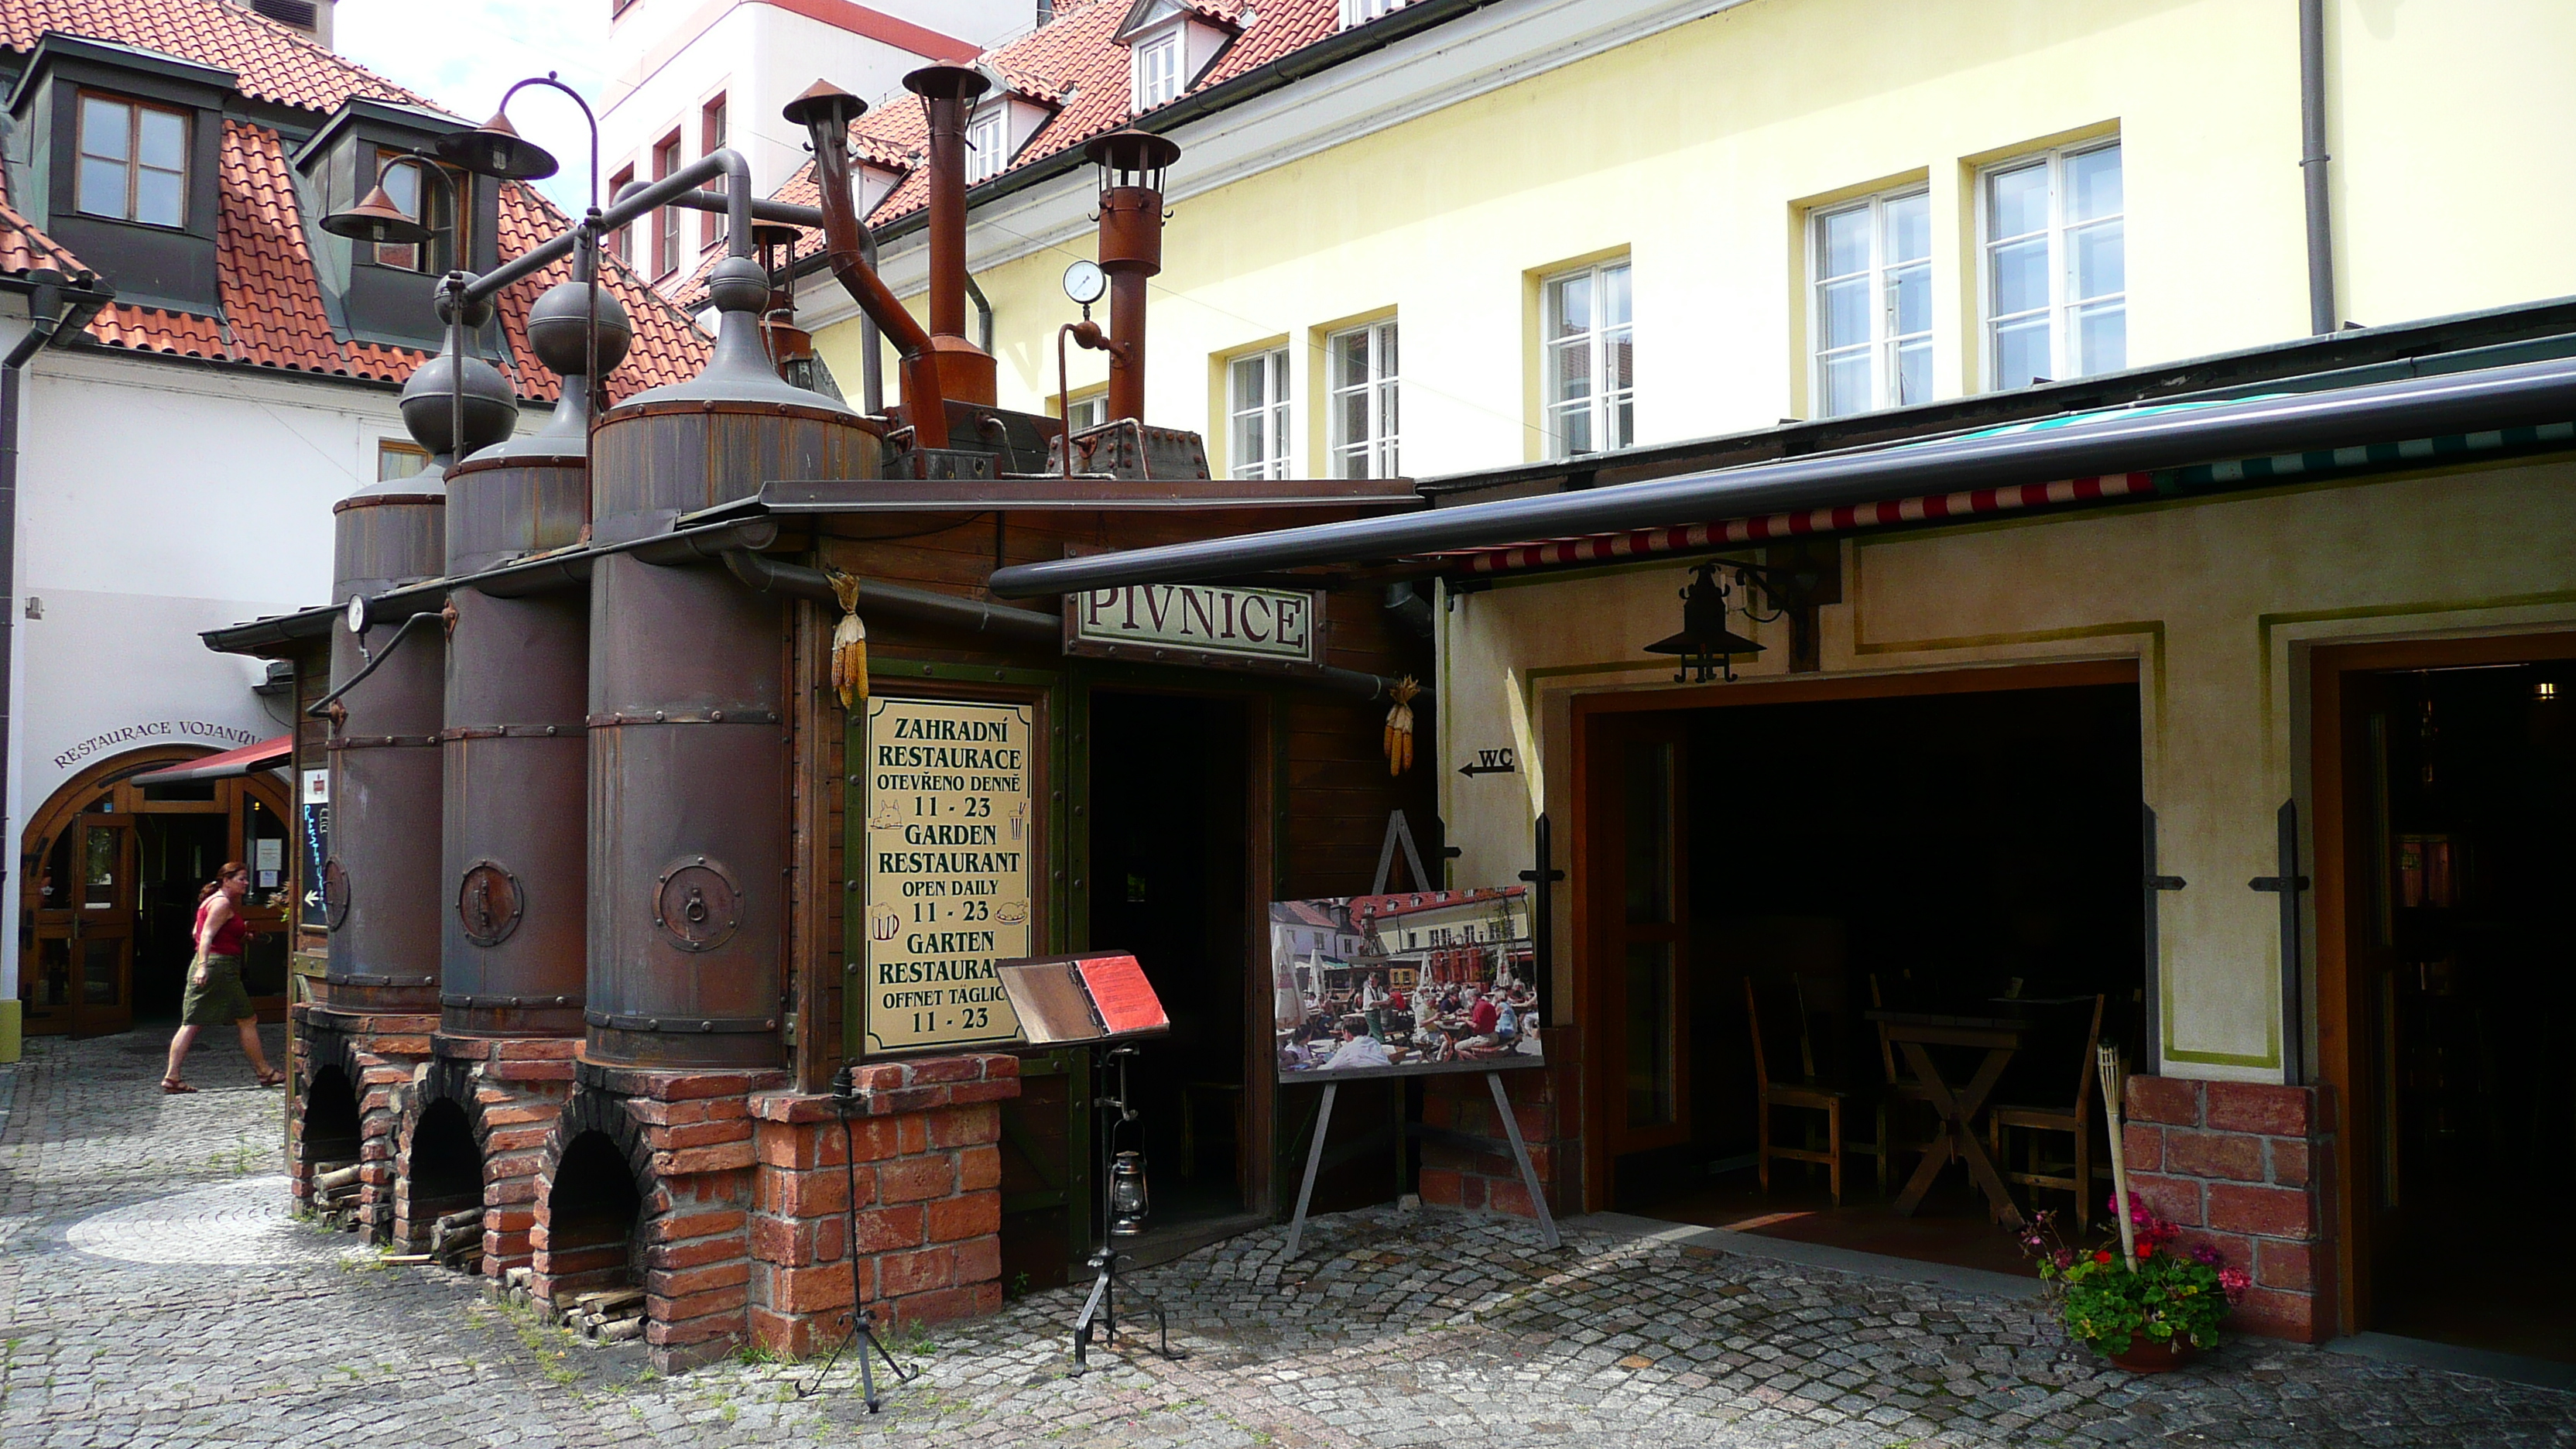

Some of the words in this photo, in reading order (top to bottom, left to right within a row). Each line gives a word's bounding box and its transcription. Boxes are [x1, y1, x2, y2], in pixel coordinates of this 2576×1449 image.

[1088, 584, 1303, 649] PIVNICE
[894, 716, 1009, 742] ZAHRADNÍ
[53, 721, 171, 769] RESTAURACE
[179, 721, 262, 745] VOJANŮV
[879, 745, 1022, 769] RESTAURACE
[1478, 748, 1512, 766] WC
[877, 771, 964, 790] OTEVŘENO
[971, 774, 1020, 792] DENNĚ
[915, 796, 937, 816] 11
[964, 796, 991, 817] 23
[905, 824, 997, 845] GARDEN
[879, 852, 1020, 873] RESTAURANT
[903, 881, 945, 897] OPEN
[951, 879, 999, 896] DAILY
[913, 902, 936, 922] 11
[963, 900, 988, 921] 23
[907, 931, 995, 954] GARTEN
[879, 958, 1008, 985] RESTAURA
[883, 990, 943, 1009] OFFNET
[949, 984, 1008, 1005] TÄGLIC
[913, 1011, 935, 1033] 11
[962, 1007, 988, 1029] 23
